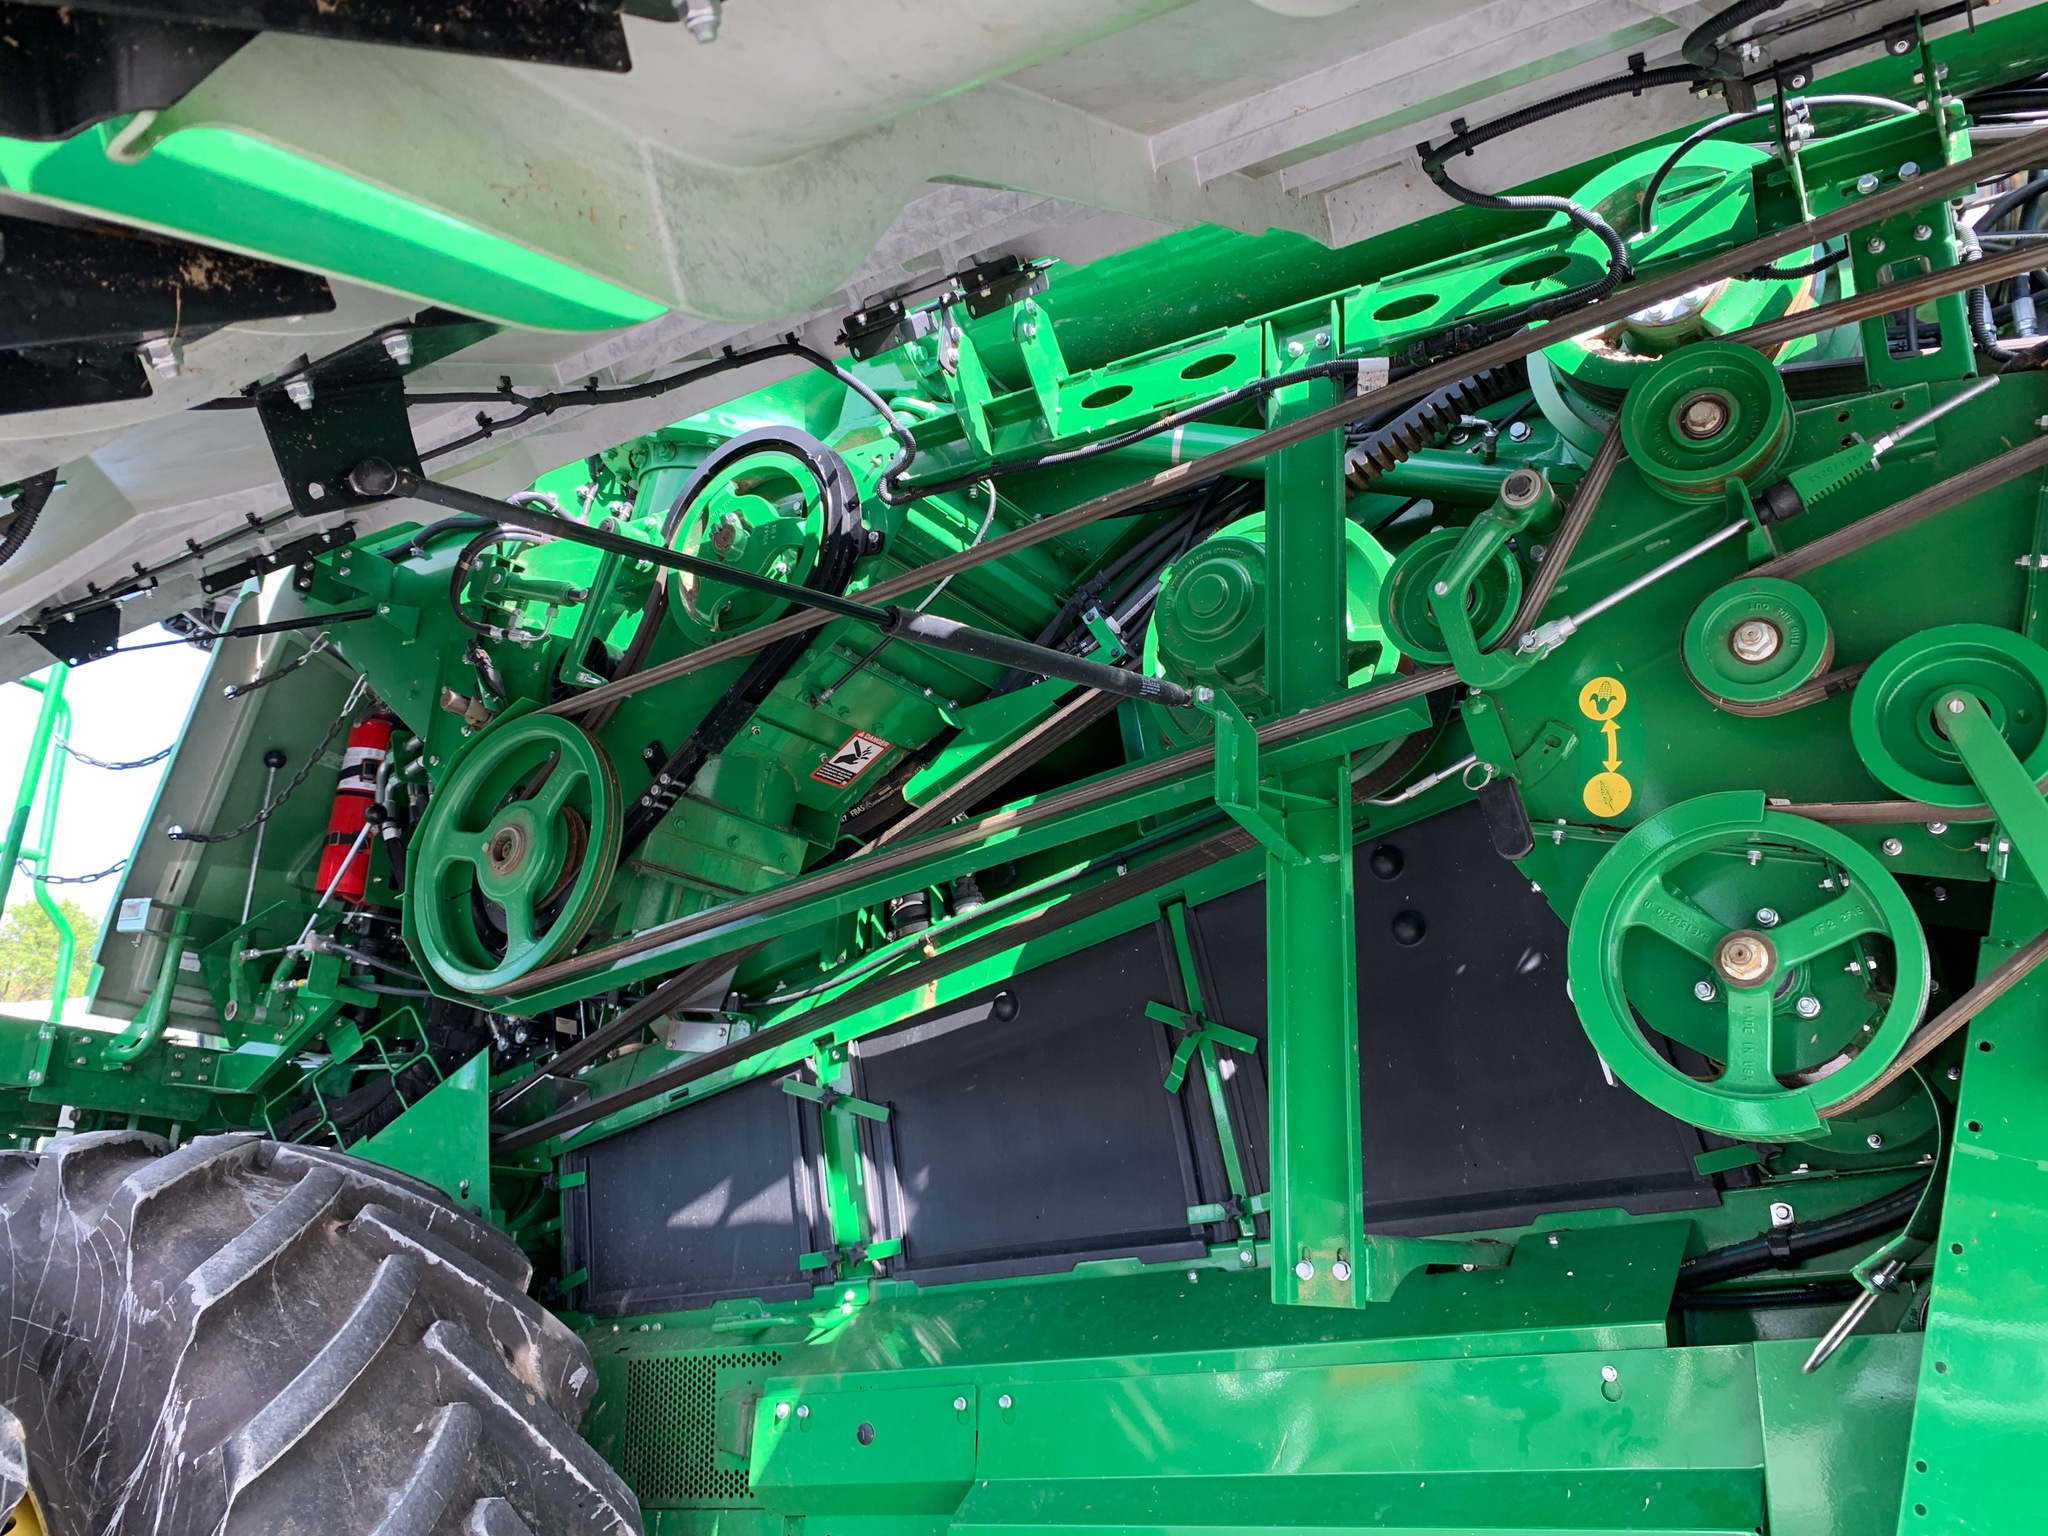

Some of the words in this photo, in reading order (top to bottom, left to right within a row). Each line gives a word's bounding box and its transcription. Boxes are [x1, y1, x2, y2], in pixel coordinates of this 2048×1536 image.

[1747, 602, 1770, 611] OUT
[1776, 606, 1794, 624] SIDE
[1789, 626, 1800, 648] THIS
[865, 734, 890, 747] DANGER
[850, 804, 866, 817] FRAS
[1826, 919, 1836, 929] 2
[1743, 1005, 1755, 1034] MADE
[1743, 1041, 1754, 1054] IN
